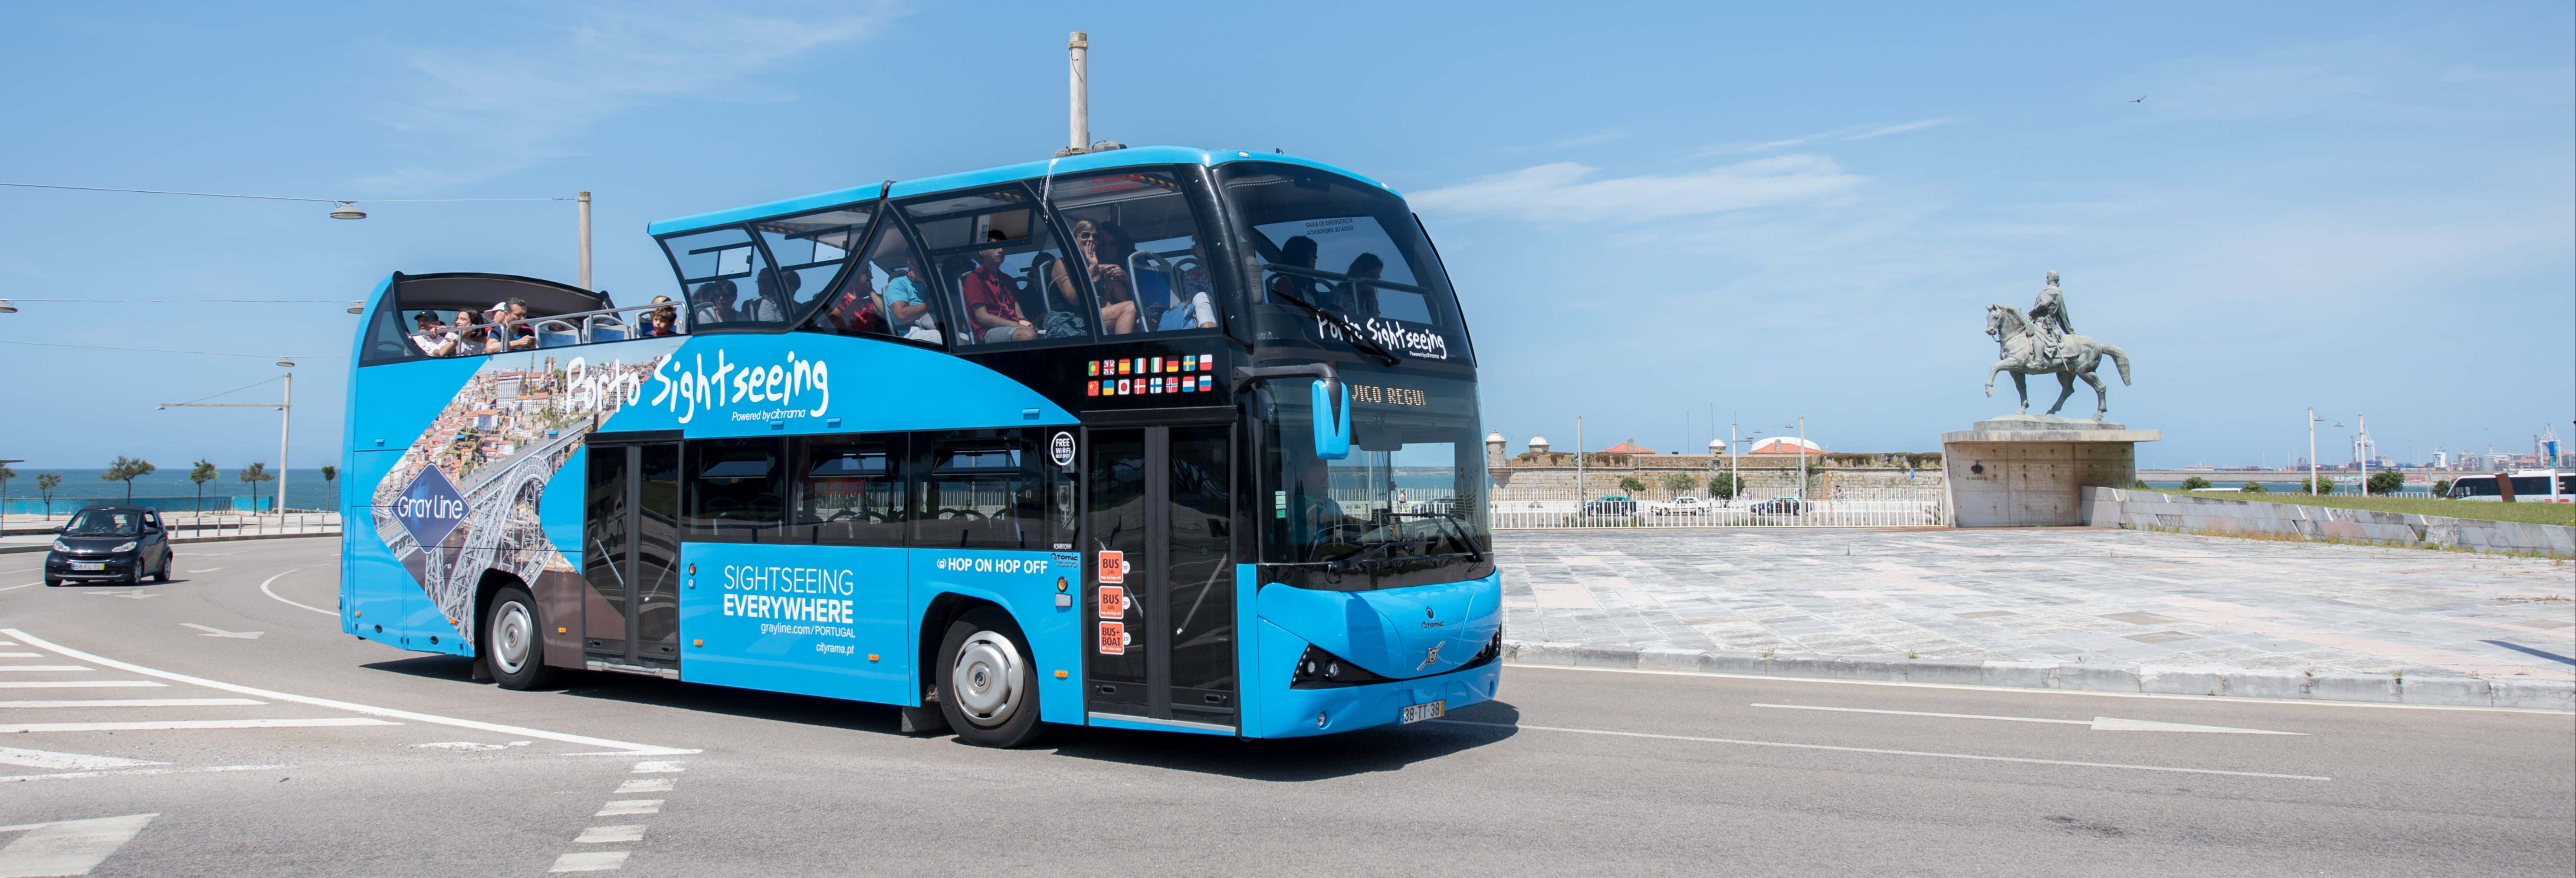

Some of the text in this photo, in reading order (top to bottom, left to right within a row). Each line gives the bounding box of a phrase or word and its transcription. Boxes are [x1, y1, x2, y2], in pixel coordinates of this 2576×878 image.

[1366, 318, 1447, 360] Sightseeing
[566, 348, 829, 424] Porto Sightseeing
[732, 410, 761, 422] Powered
[1056, 438, 1070, 447] FREE
[398, 496, 433, 518] Gray
[948, 557, 1048, 574] HOP ON HOP OFF
[1103, 558, 1119, 569] BUS
[724, 565, 853, 596] SIGHTSEEING
[1103, 594, 1119, 604] BUS
[724, 593, 853, 624] EVERYWHERE
[816, 642, 854, 656] cityrama.pt
[1102, 637, 1120, 646] BOAT
